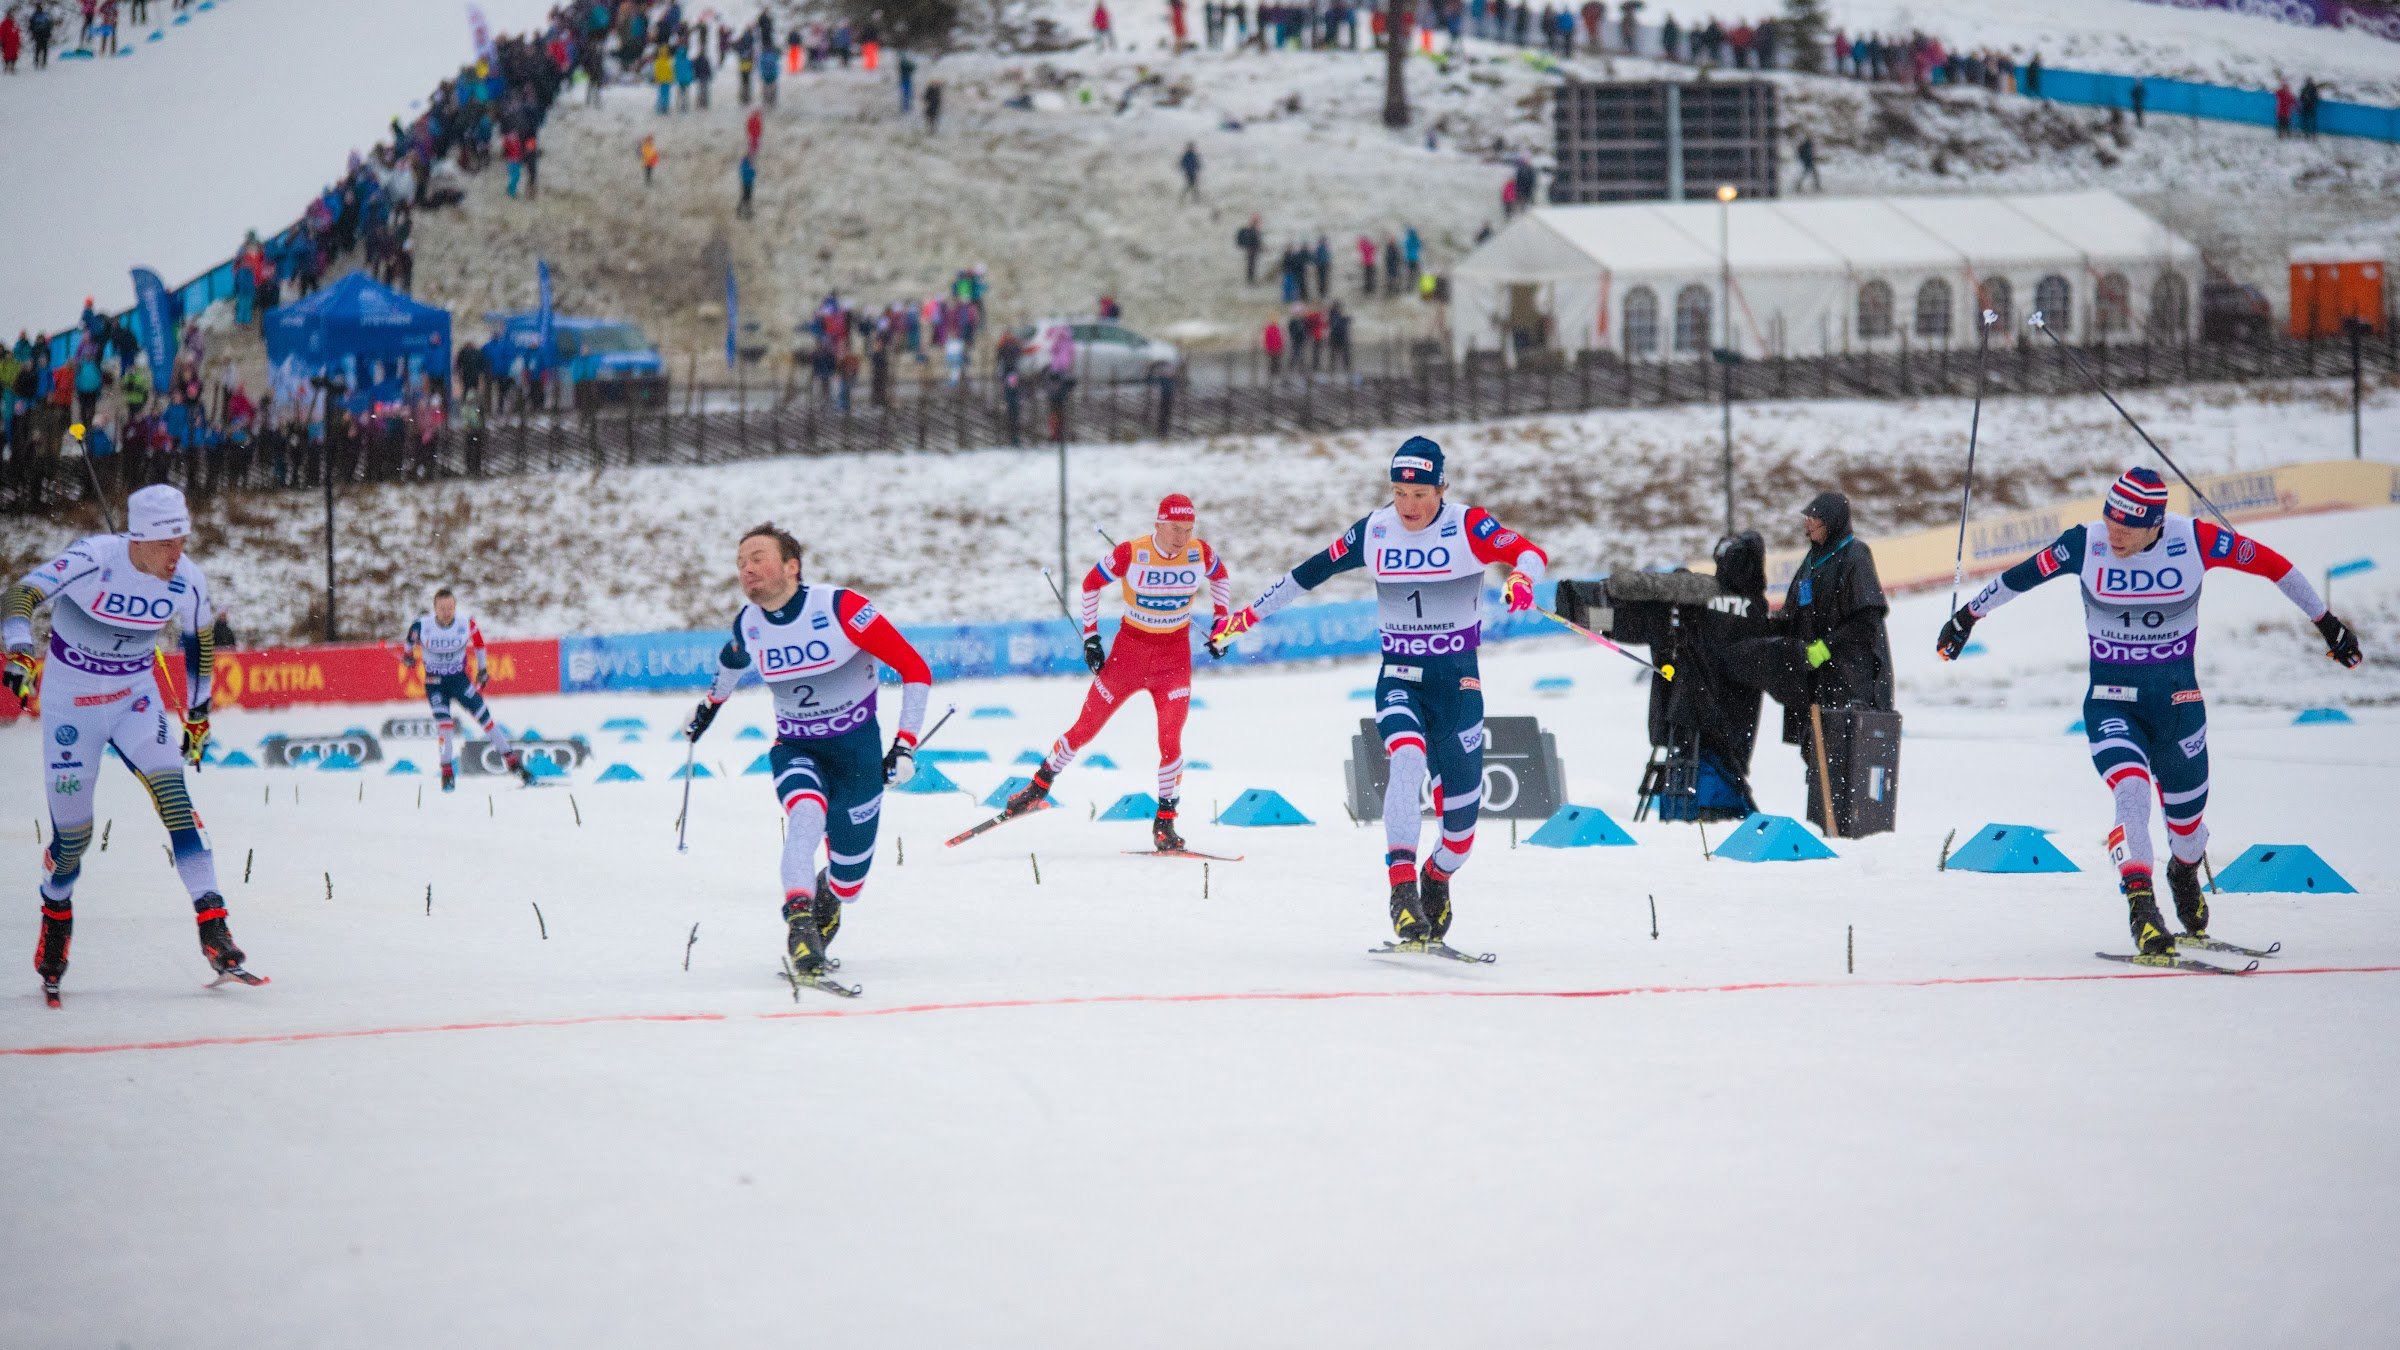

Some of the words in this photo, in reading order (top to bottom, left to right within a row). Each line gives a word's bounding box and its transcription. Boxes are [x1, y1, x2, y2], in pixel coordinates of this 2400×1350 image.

[1384, 546, 1450, 570] BDO
[1146, 570, 1197, 586] BDO
[2107, 567, 2183, 592] BDO
[105, 592, 173, 619] BDO
[1407, 590, 1423, 619] 1
[1385, 621, 1455, 632] LILLEHAMMER
[2116, 610, 2165, 629] 10
[430, 639, 462, 649] BDO
[1382, 633, 1466, 656] OneCo
[2101, 629, 2180, 641] LILLEHAMMER
[64, 646, 155, 673] OneCo
[767, 640, 829, 669] BDO
[2092, 639, 2187, 661] OneCo
[249, 662, 325, 694] EXTRA
[793, 684, 820, 709] 2
[777, 706, 869, 738] OneCo
